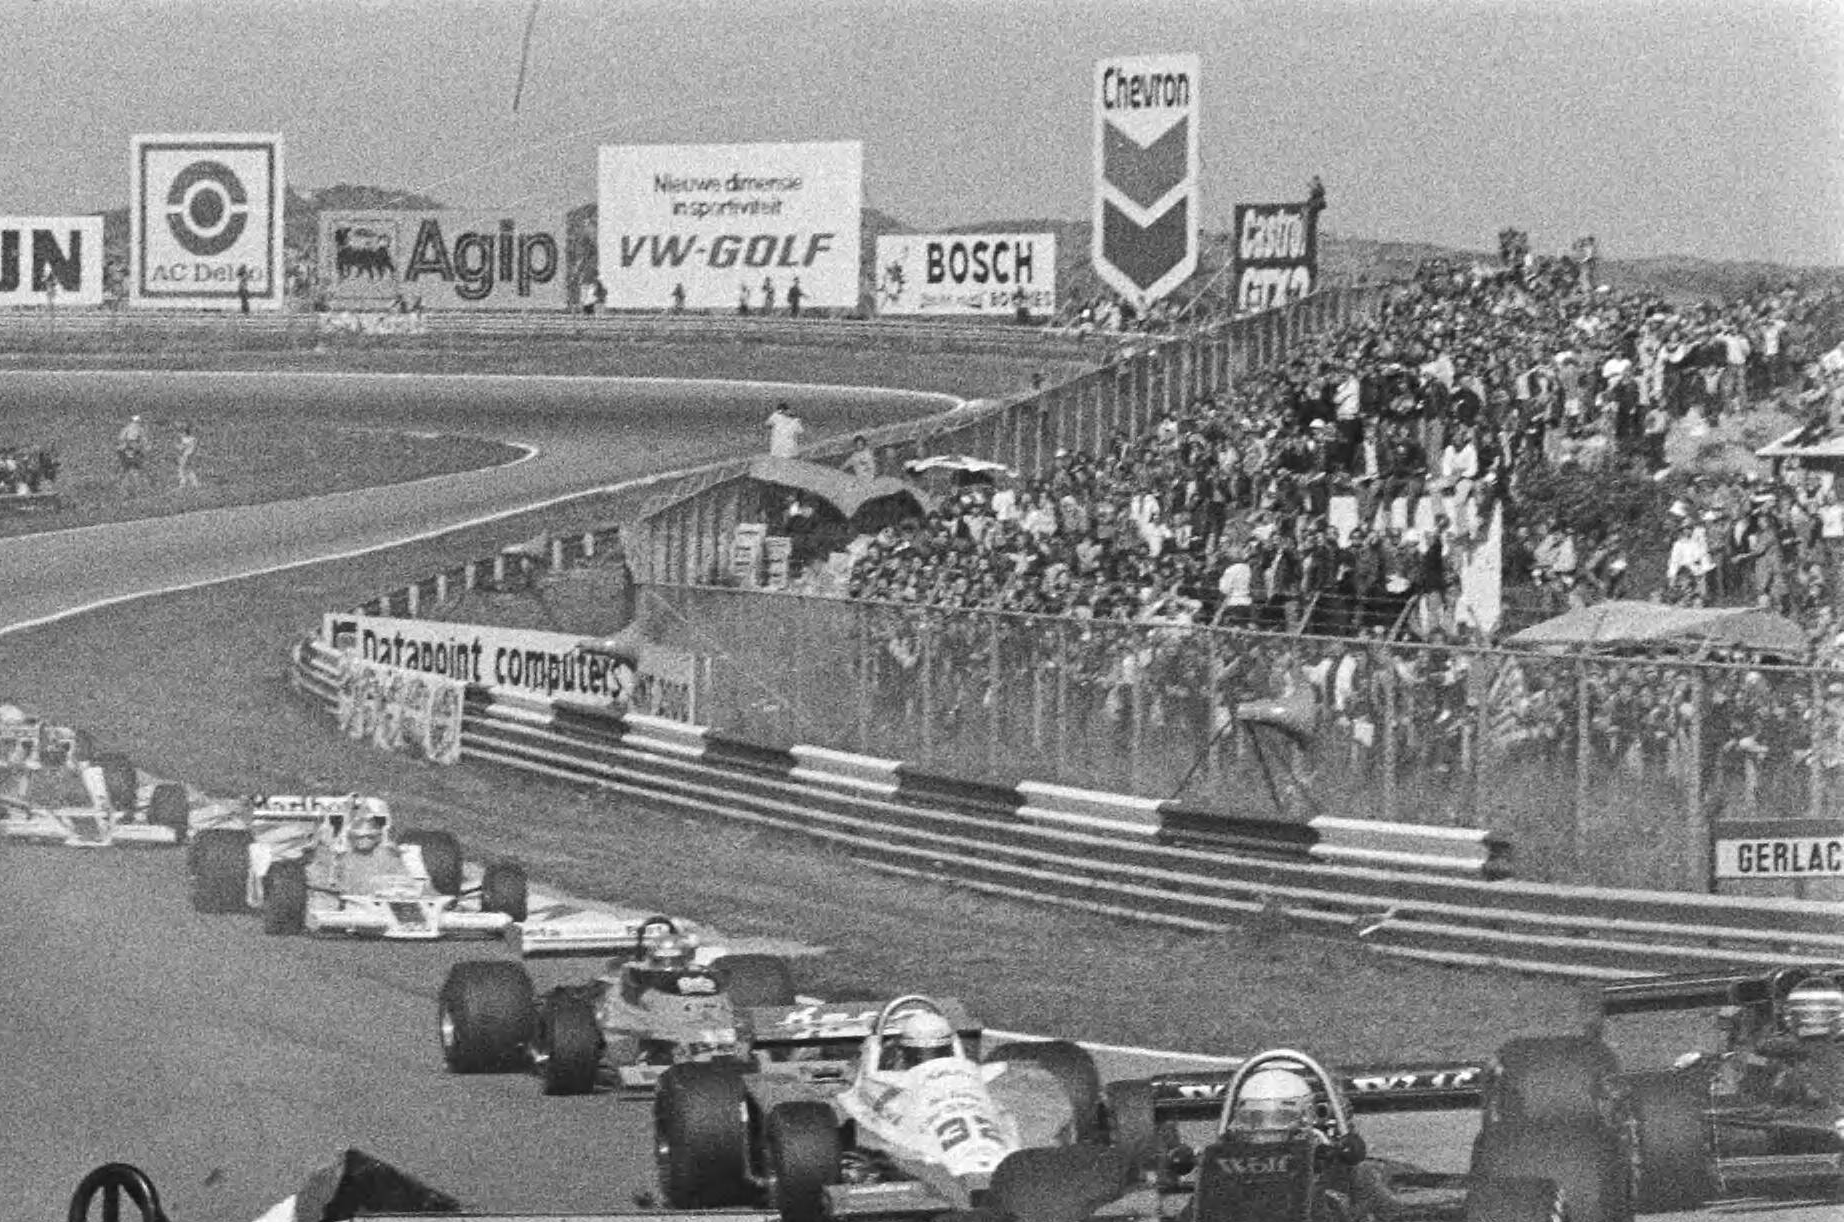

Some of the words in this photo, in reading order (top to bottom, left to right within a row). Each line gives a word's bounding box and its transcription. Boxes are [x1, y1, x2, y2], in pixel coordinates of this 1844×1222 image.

[1103, 66, 1189, 109] Chevron
[654, 173, 721, 193] Nieuwe
[725, 172, 803, 192] dimensie
[405, 219, 557, 300] Agip
[621, 233, 835, 267] VW-GOLF
[927, 241, 1033, 284] BOSCH
[151, 263, 188, 282] AC
[495, 645, 624, 698] computers
